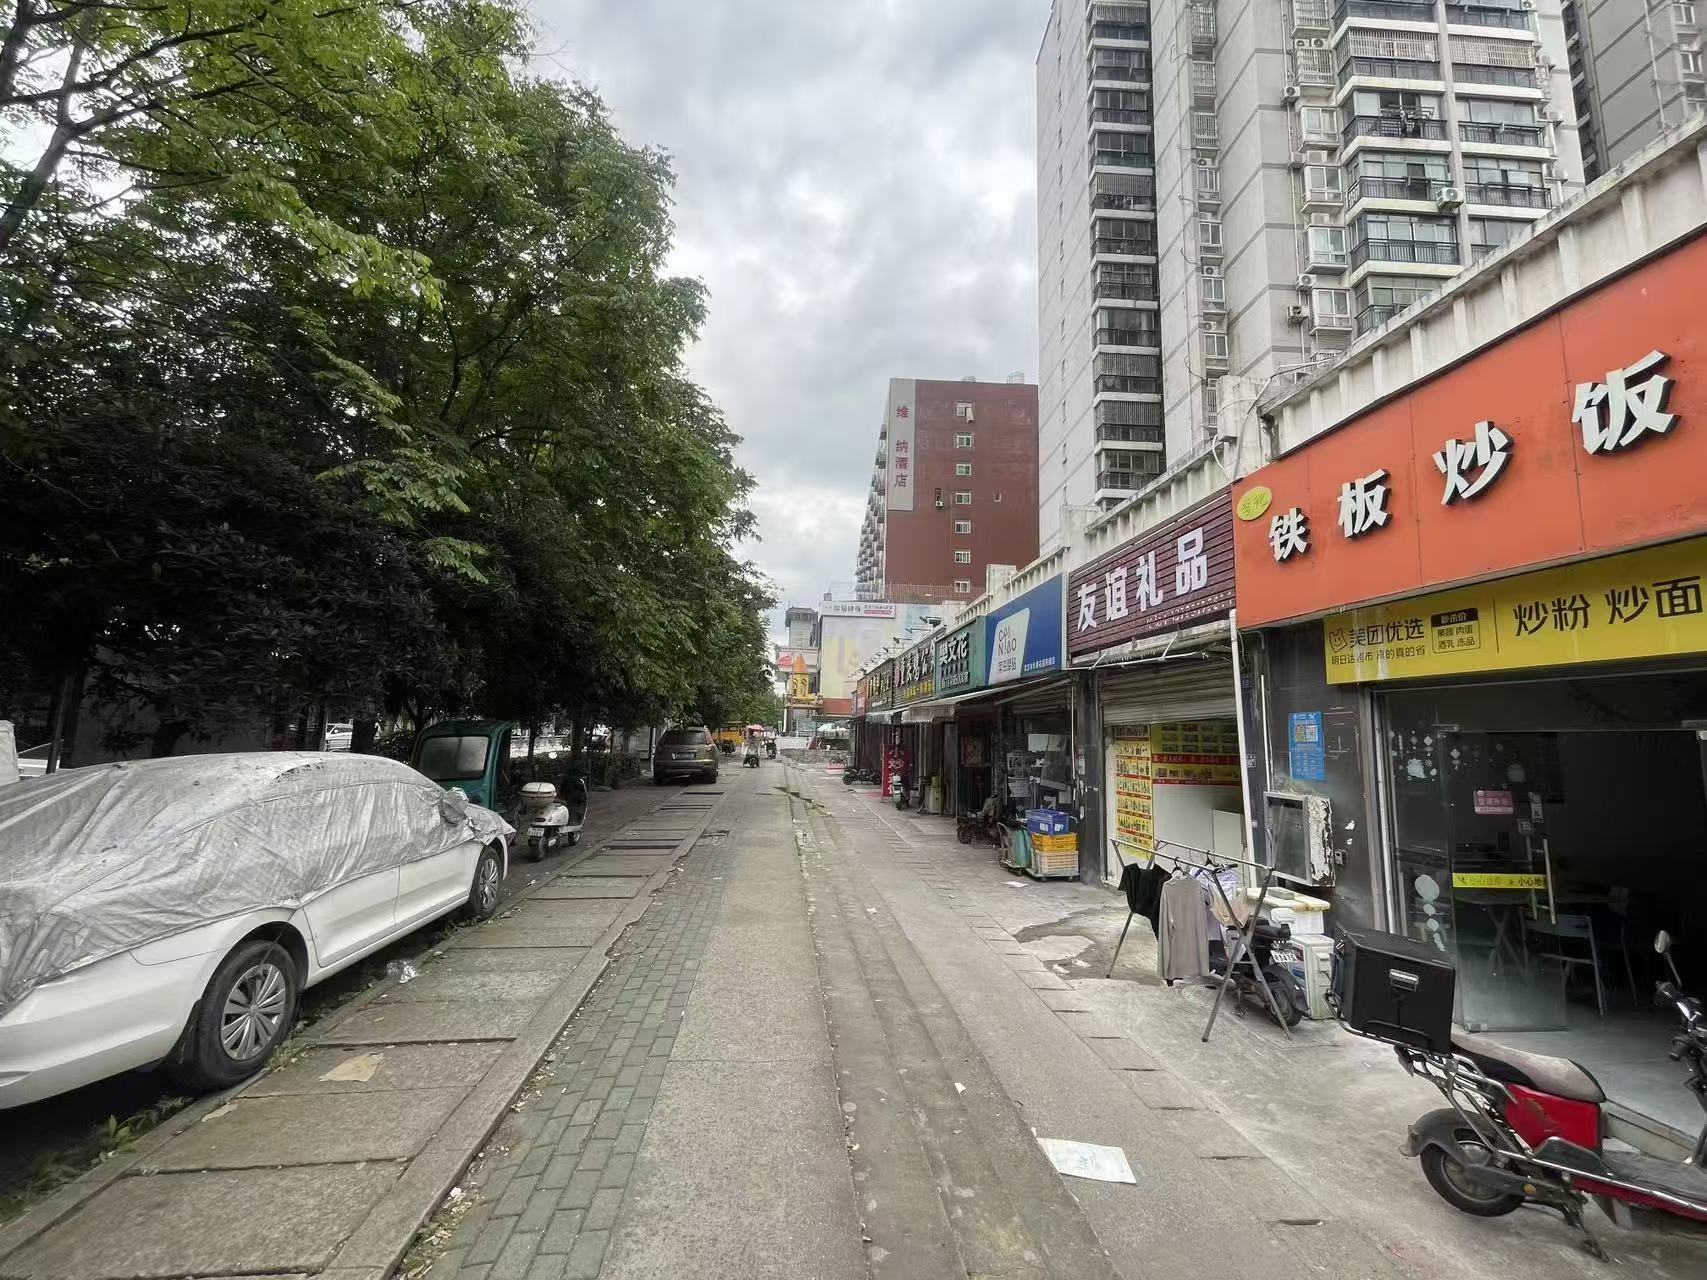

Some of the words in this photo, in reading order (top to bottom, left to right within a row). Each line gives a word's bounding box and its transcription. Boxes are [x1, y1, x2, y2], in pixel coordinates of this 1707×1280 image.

[894, 404, 910, 488] 维纳酒店
[1268, 349, 1682, 563] 铁板炒饭
[1077, 527, 1208, 632] 友谊礼品
[1513, 593, 1592, 637] 炒粉
[1604, 575, 1704, 625] 炒面
[1349, 617, 1426, 648] 美团优选
